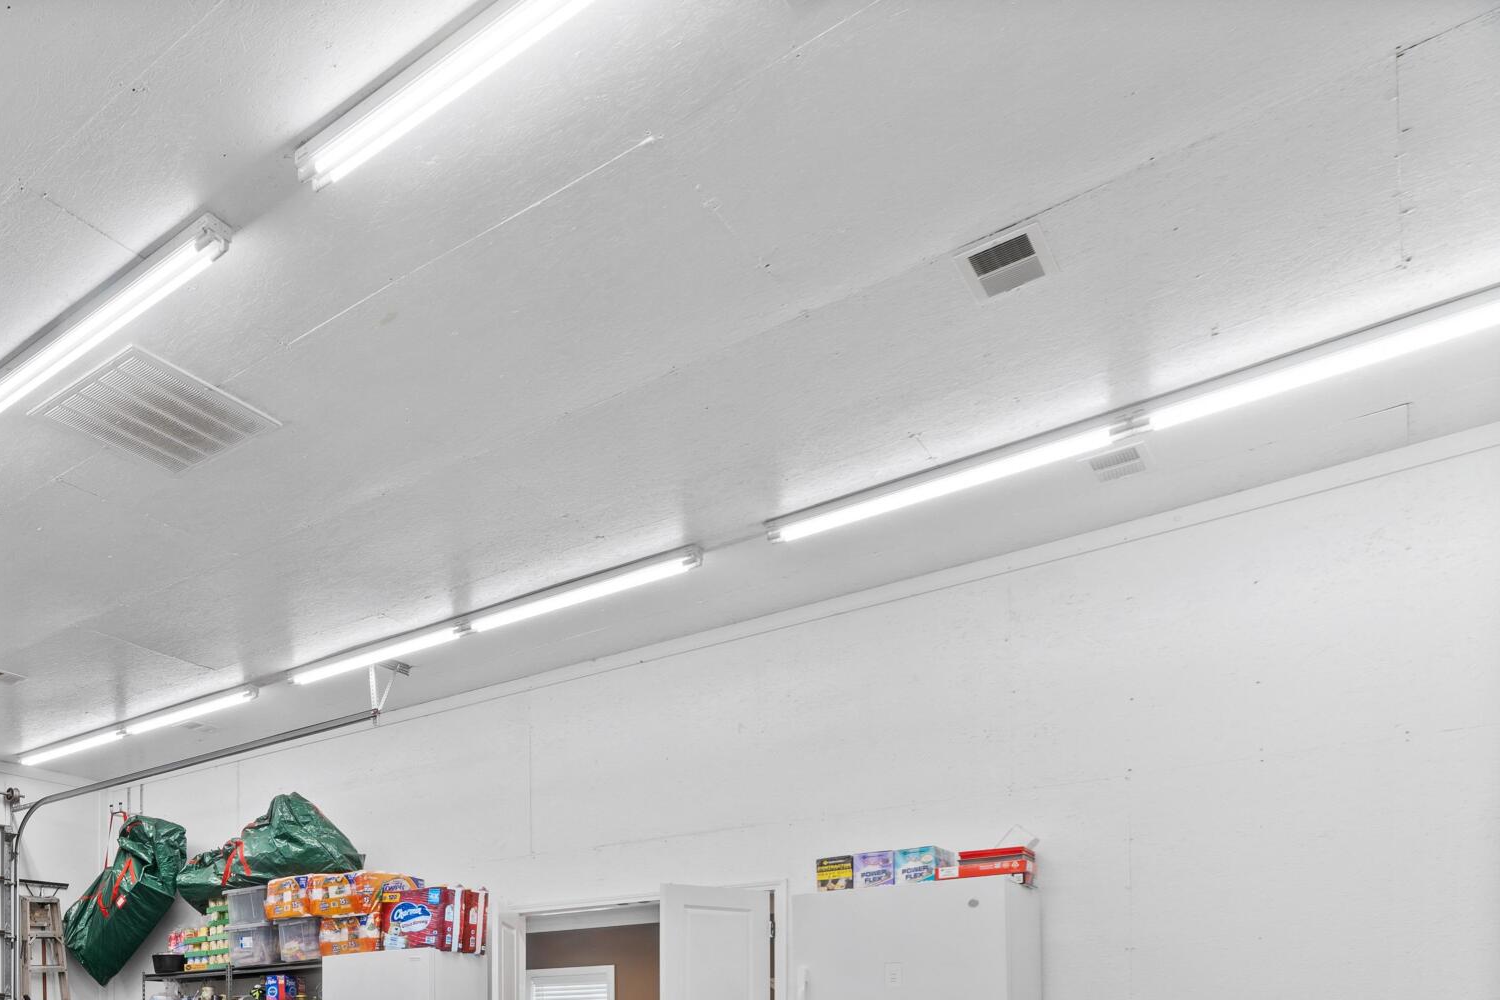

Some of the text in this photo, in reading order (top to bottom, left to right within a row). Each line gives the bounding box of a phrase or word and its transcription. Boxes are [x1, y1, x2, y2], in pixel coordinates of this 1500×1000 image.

[861, 869, 888, 878] POWER
[902, 865, 929, 874] POWER
[864, 876, 884, 884] FLEX
[394, 906, 422, 920] Charmin
